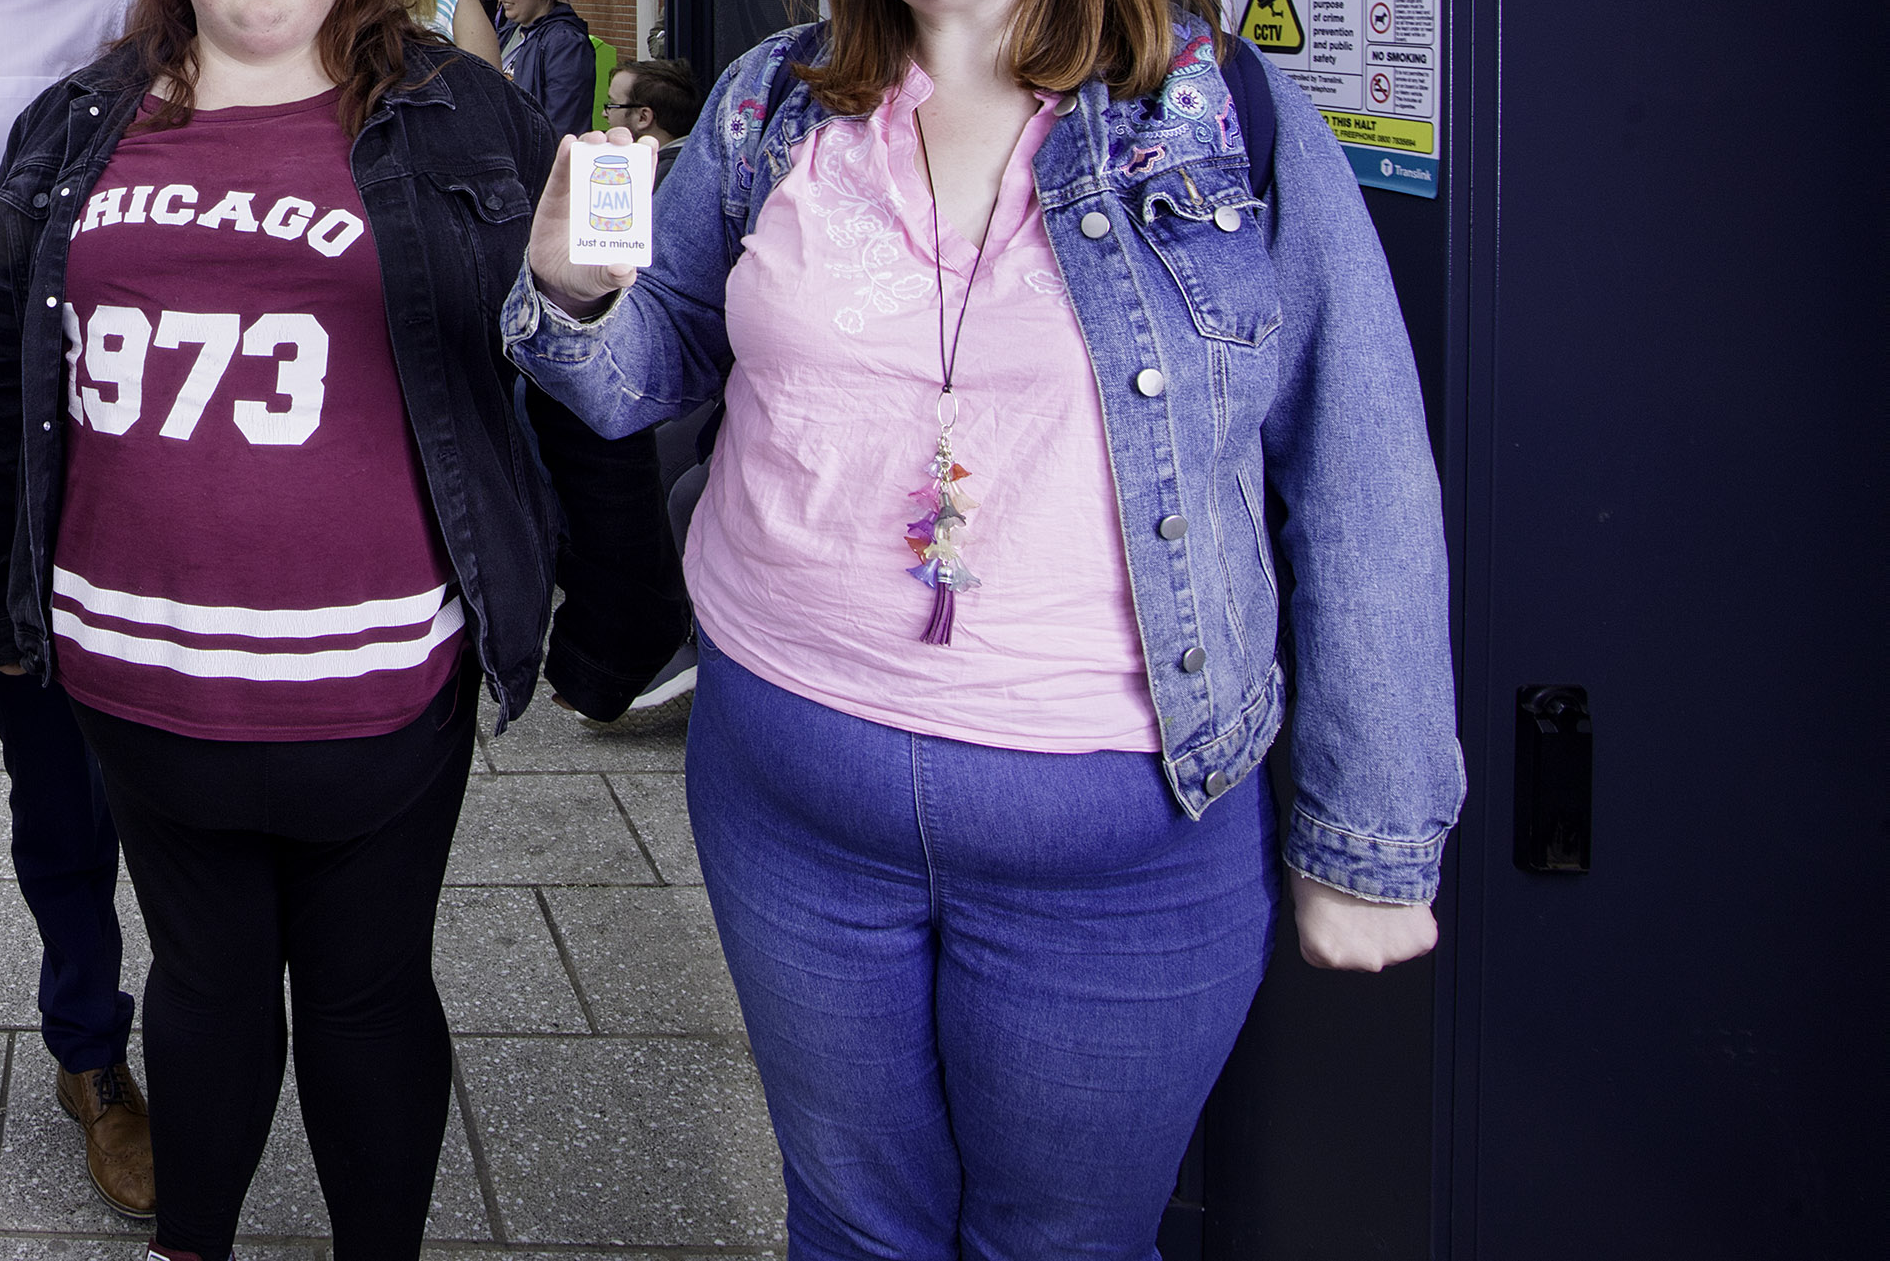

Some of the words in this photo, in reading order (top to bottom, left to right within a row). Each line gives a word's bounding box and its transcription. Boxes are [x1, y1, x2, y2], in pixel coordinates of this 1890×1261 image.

[1313, 0, 1344, 11] purpose
[1313, 13, 1321, 23] of
[1323, 13, 1345, 23] crime
[1254, 24, 1282, 41] CCTV
[1313, 27, 1354, 38] prevention
[1313, 41, 1328, 50] and
[1329, 41, 1354, 52] public
[1313, 54, 1337, 65] safety
[1372, 51, 1385, 61] NO
[1387, 52, 1427, 64] SMOKING
[1332, 116, 1352, 128] THIS
[1354, 119, 1377, 131] HALT
[1394, 164, 1432, 181] Translink
[593, 191, 630, 210] JAM
[68, 184, 365, 257] HICAGO
[577, 238, 597, 248] Just
[599, 239, 607, 248] a
[610, 238, 645, 250] minute
